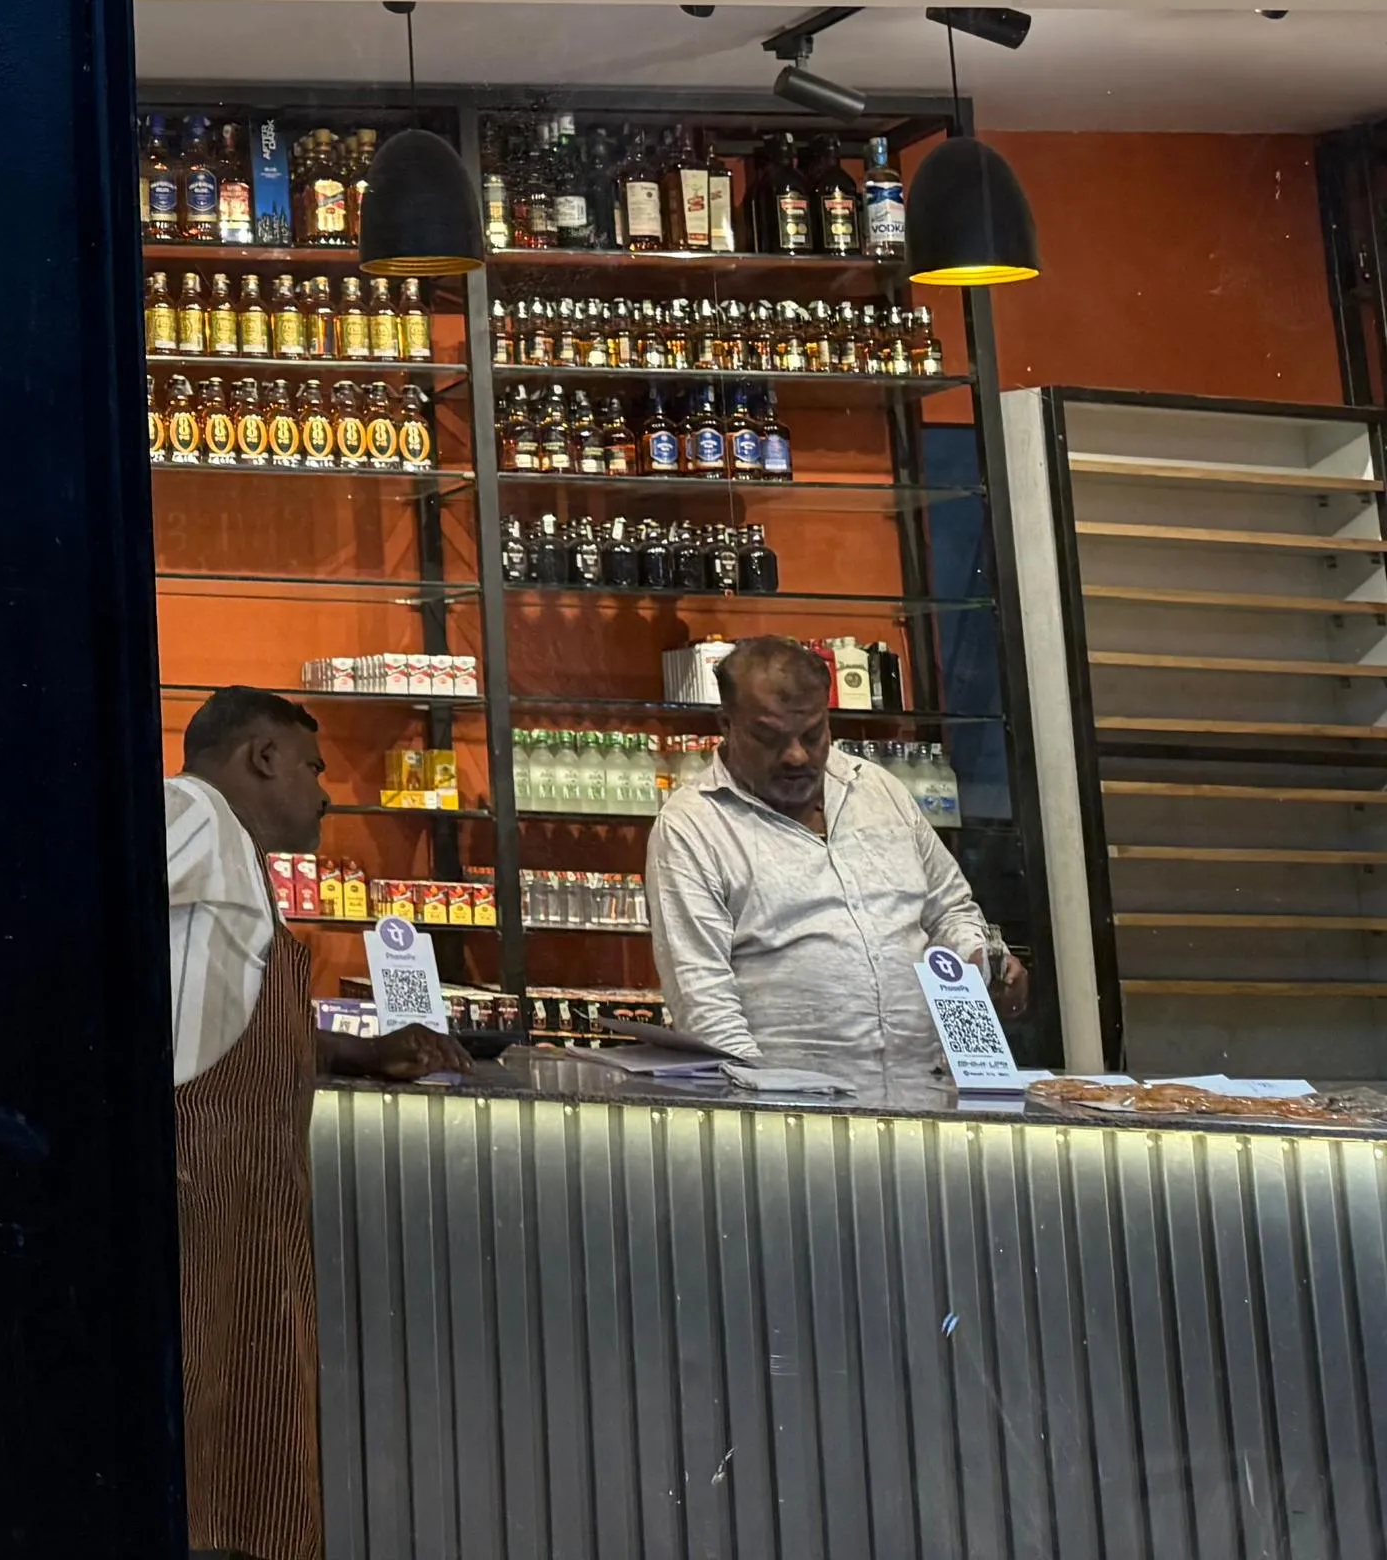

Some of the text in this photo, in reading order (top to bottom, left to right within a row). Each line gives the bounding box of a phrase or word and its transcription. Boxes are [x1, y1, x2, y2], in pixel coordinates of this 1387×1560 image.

[261, 124, 272, 160] AFTER
[267, 119, 277, 150] DARK
[935, 954, 955, 978] पे
